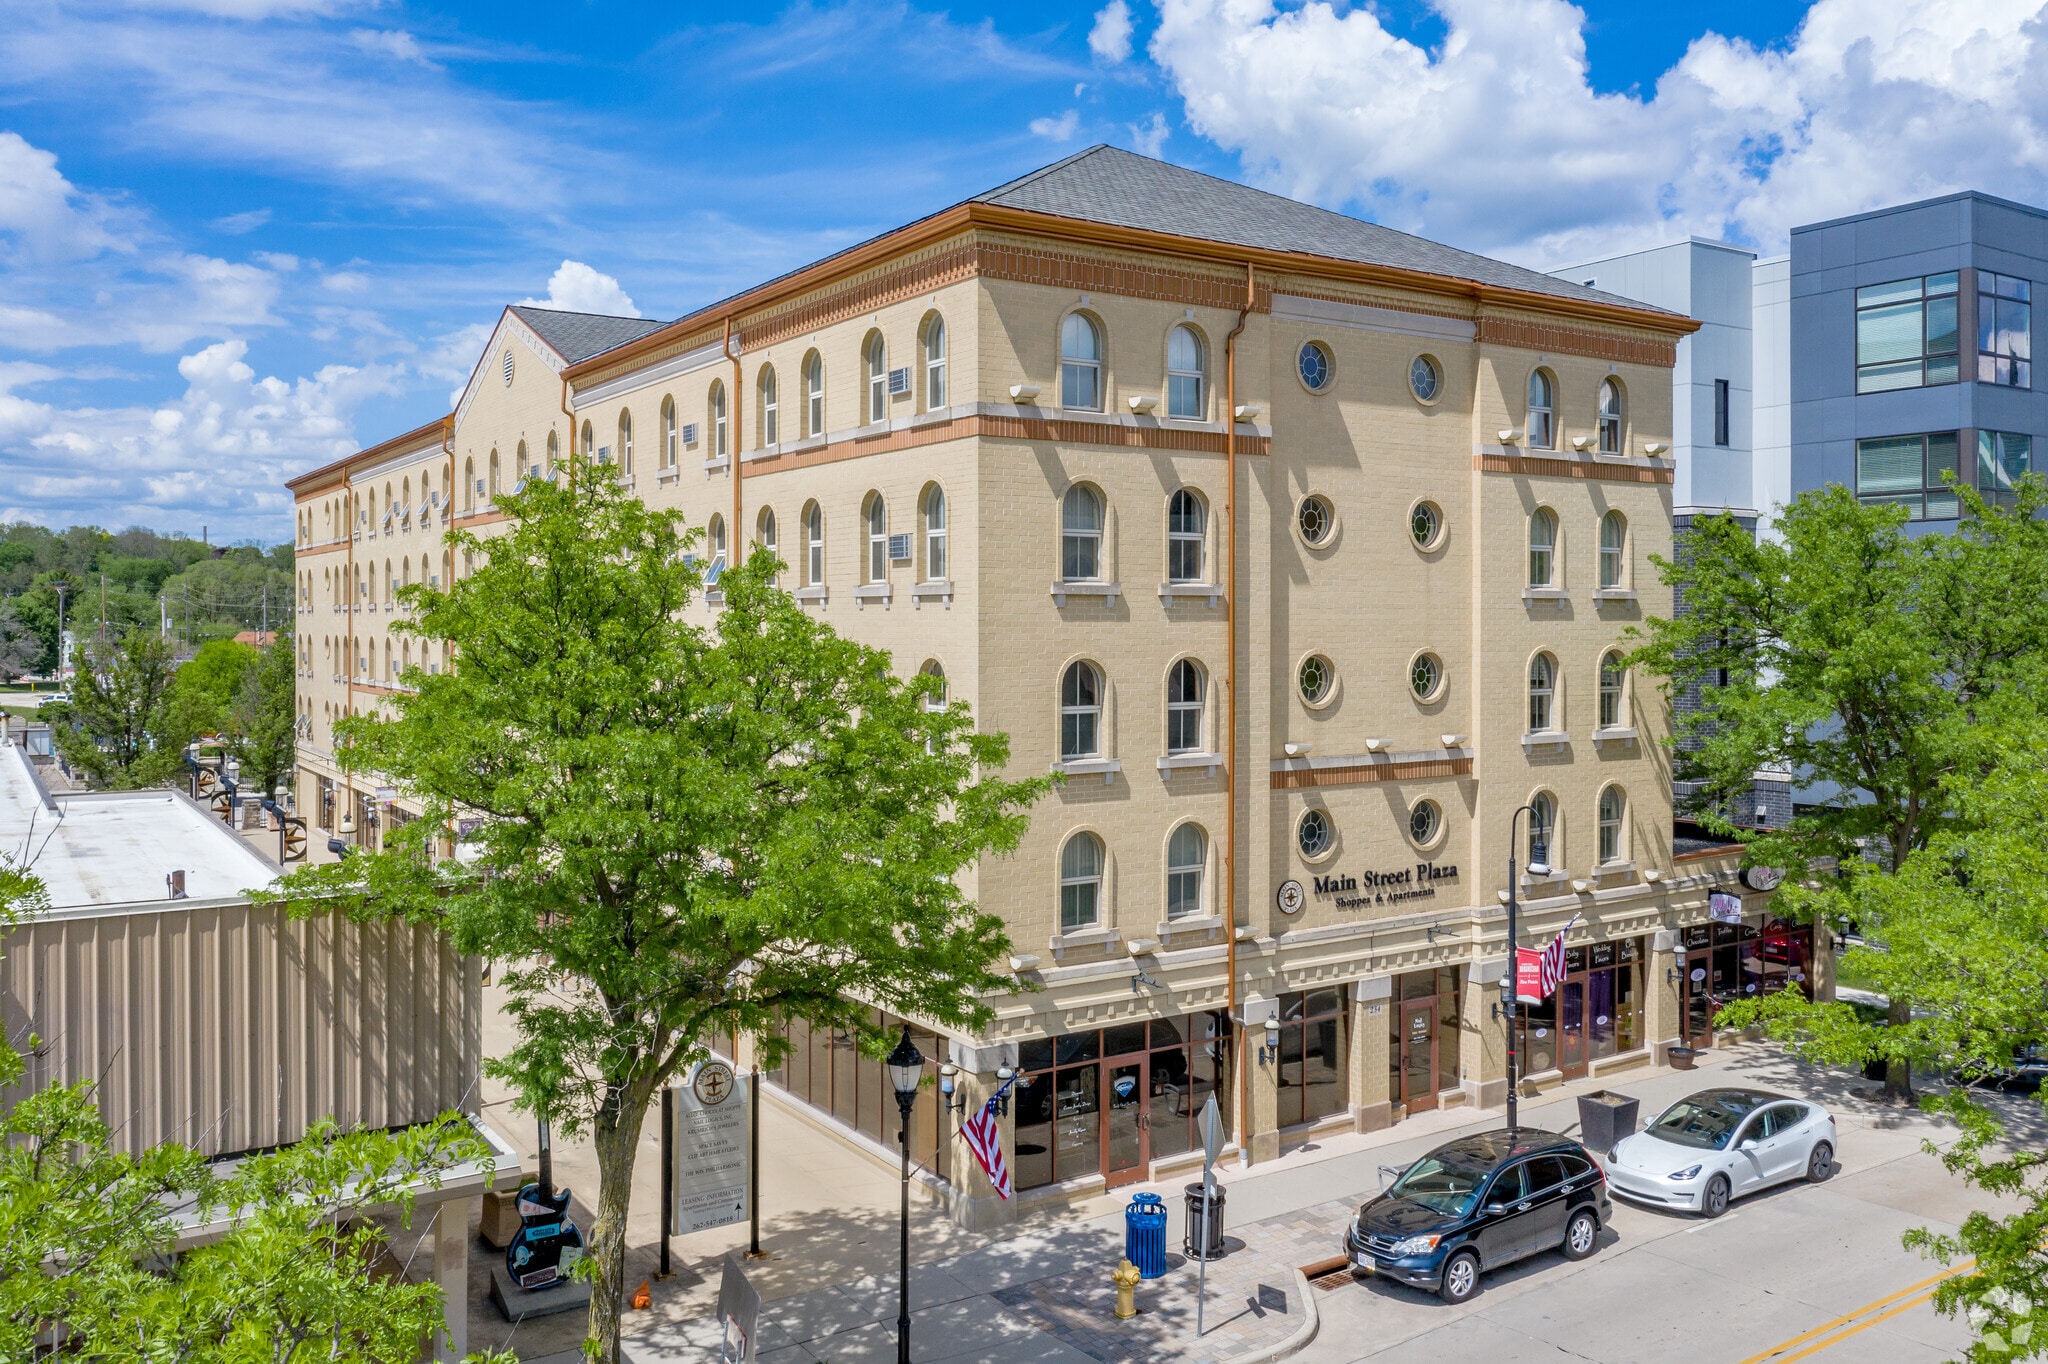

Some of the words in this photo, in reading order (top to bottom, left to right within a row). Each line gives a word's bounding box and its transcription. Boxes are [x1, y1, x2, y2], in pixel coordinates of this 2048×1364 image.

[1313, 874, 1357, 895] Main
[1363, 869, 1411, 888] Street
[1416, 861, 1458, 881] Plaza
[1335, 896, 1371, 908] Shoppes
[1375, 893, 1383, 903] &
[1387, 887, 1435, 904] Apartments
[1593, 943, 1613, 954] Wedding
[1566, 949, 1580, 960] Baby
[697, 1069, 711, 1085] MAIN
[714, 1066, 731, 1082] STREET
[704, 1094, 725, 1103] PLAZA
[717, 1121, 740, 1131] JEWELERS
[698, 1142, 712, 1150] SPACE
[721, 1145, 740, 1153] STUDIO
[705, 1161, 742, 1173] PHILHARMONIC
[681, 1195, 705, 1206] LEASING
[706, 1187, 744, 1200] INFORMATION
[682, 1202, 708, 1212] Apartments
[717, 1195, 744, 1205] Commercial
